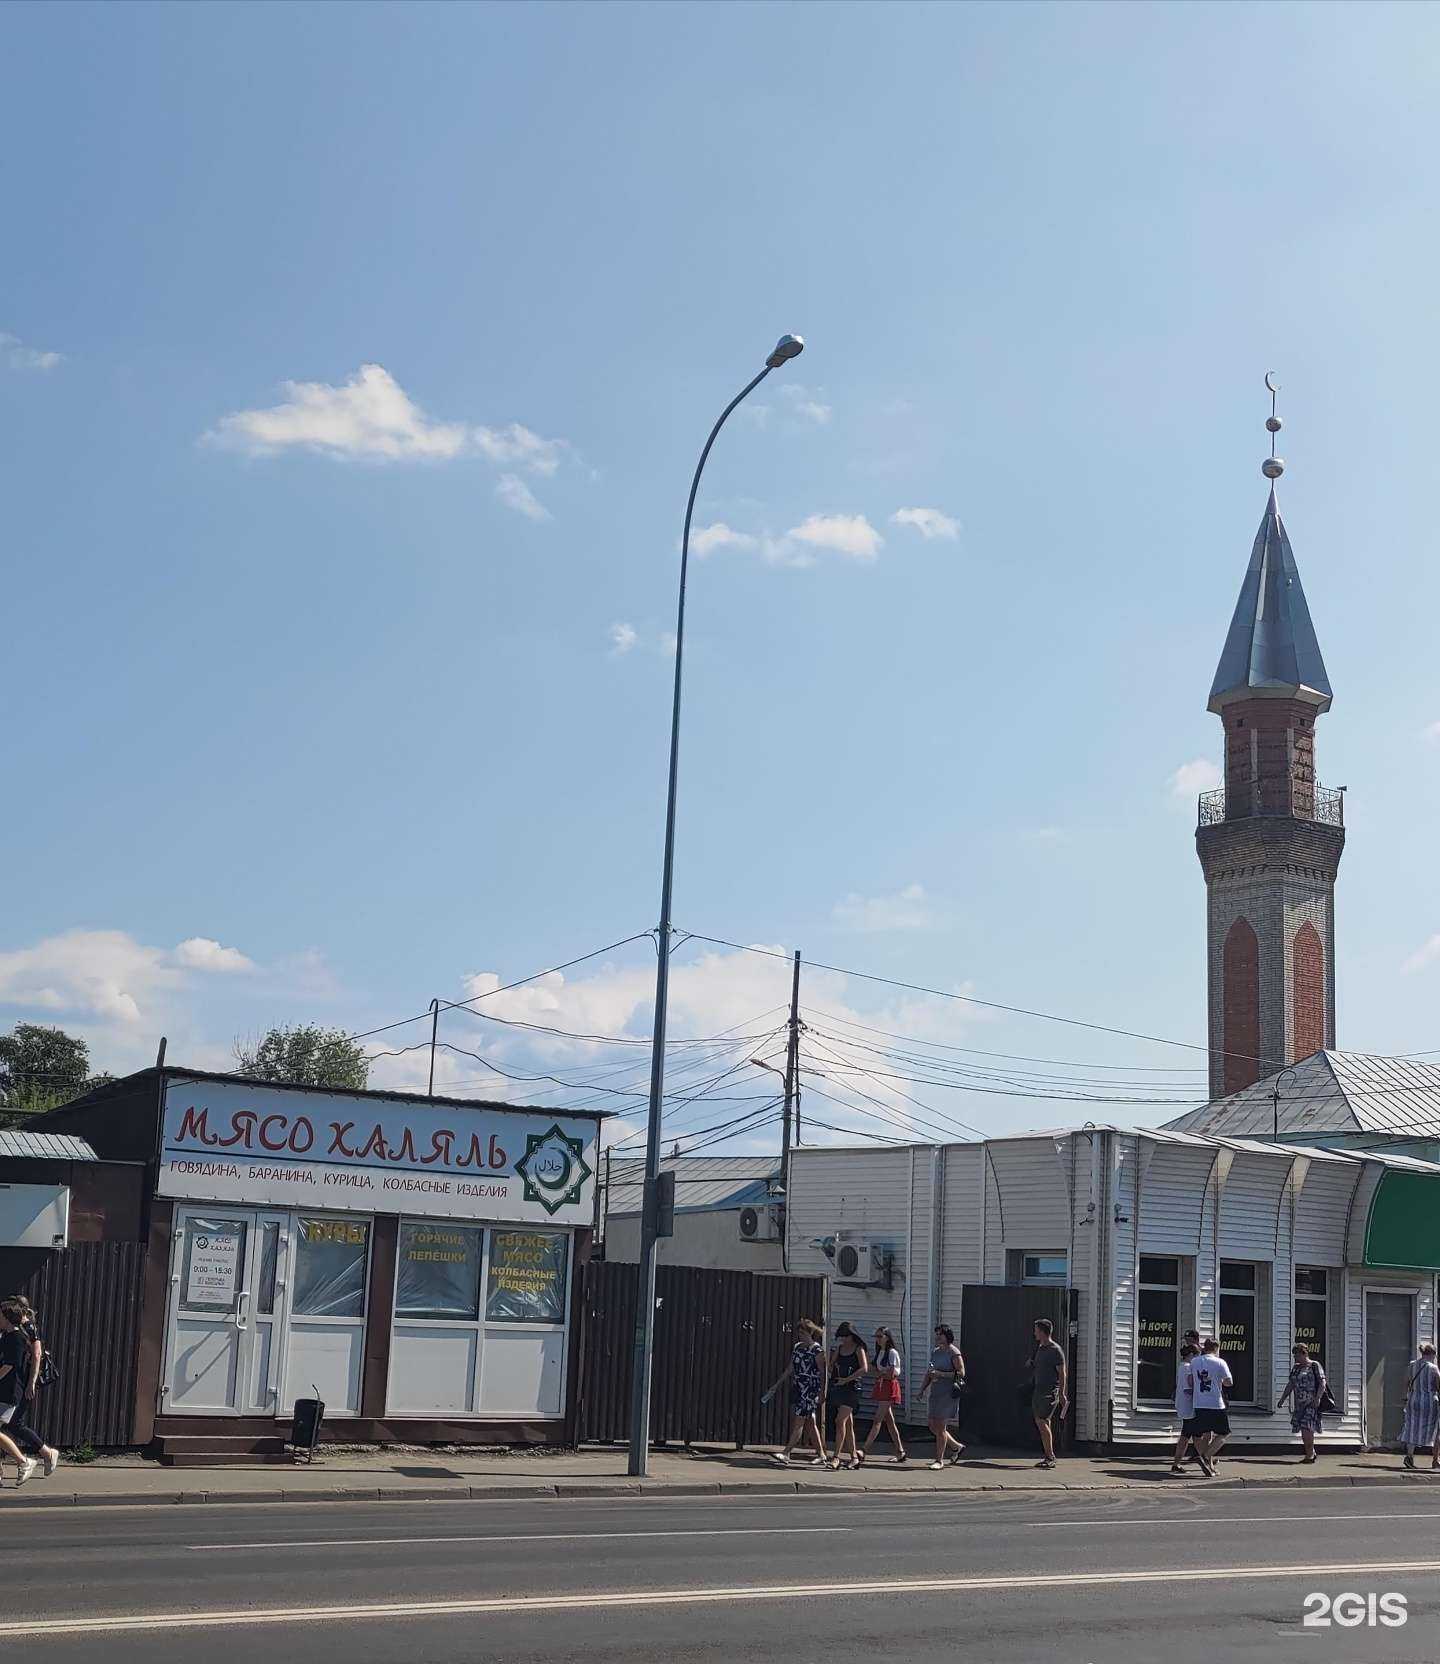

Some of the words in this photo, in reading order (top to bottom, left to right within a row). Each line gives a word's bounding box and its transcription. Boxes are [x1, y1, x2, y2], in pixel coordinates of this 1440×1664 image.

[174, 1106, 314, 1153] МЯСО
[327, 1121, 507, 1169] ХАЛЯЛЬ
[170, 1160, 241, 1180] ГОВЯДИНА,
[248, 1166, 317, 1185] БАРАНИНА,
[323, 1172, 375, 1190] КУРИЦА,
[383, 1177, 451, 1194] КОЛБАСНЫЕ
[456, 1184, 508, 1198] ИЗДЕЛИЯ
[503, 1250, 544, 1264] МЯСО
[491, 1266, 557, 1279] КОЛБАСНЫЕ
